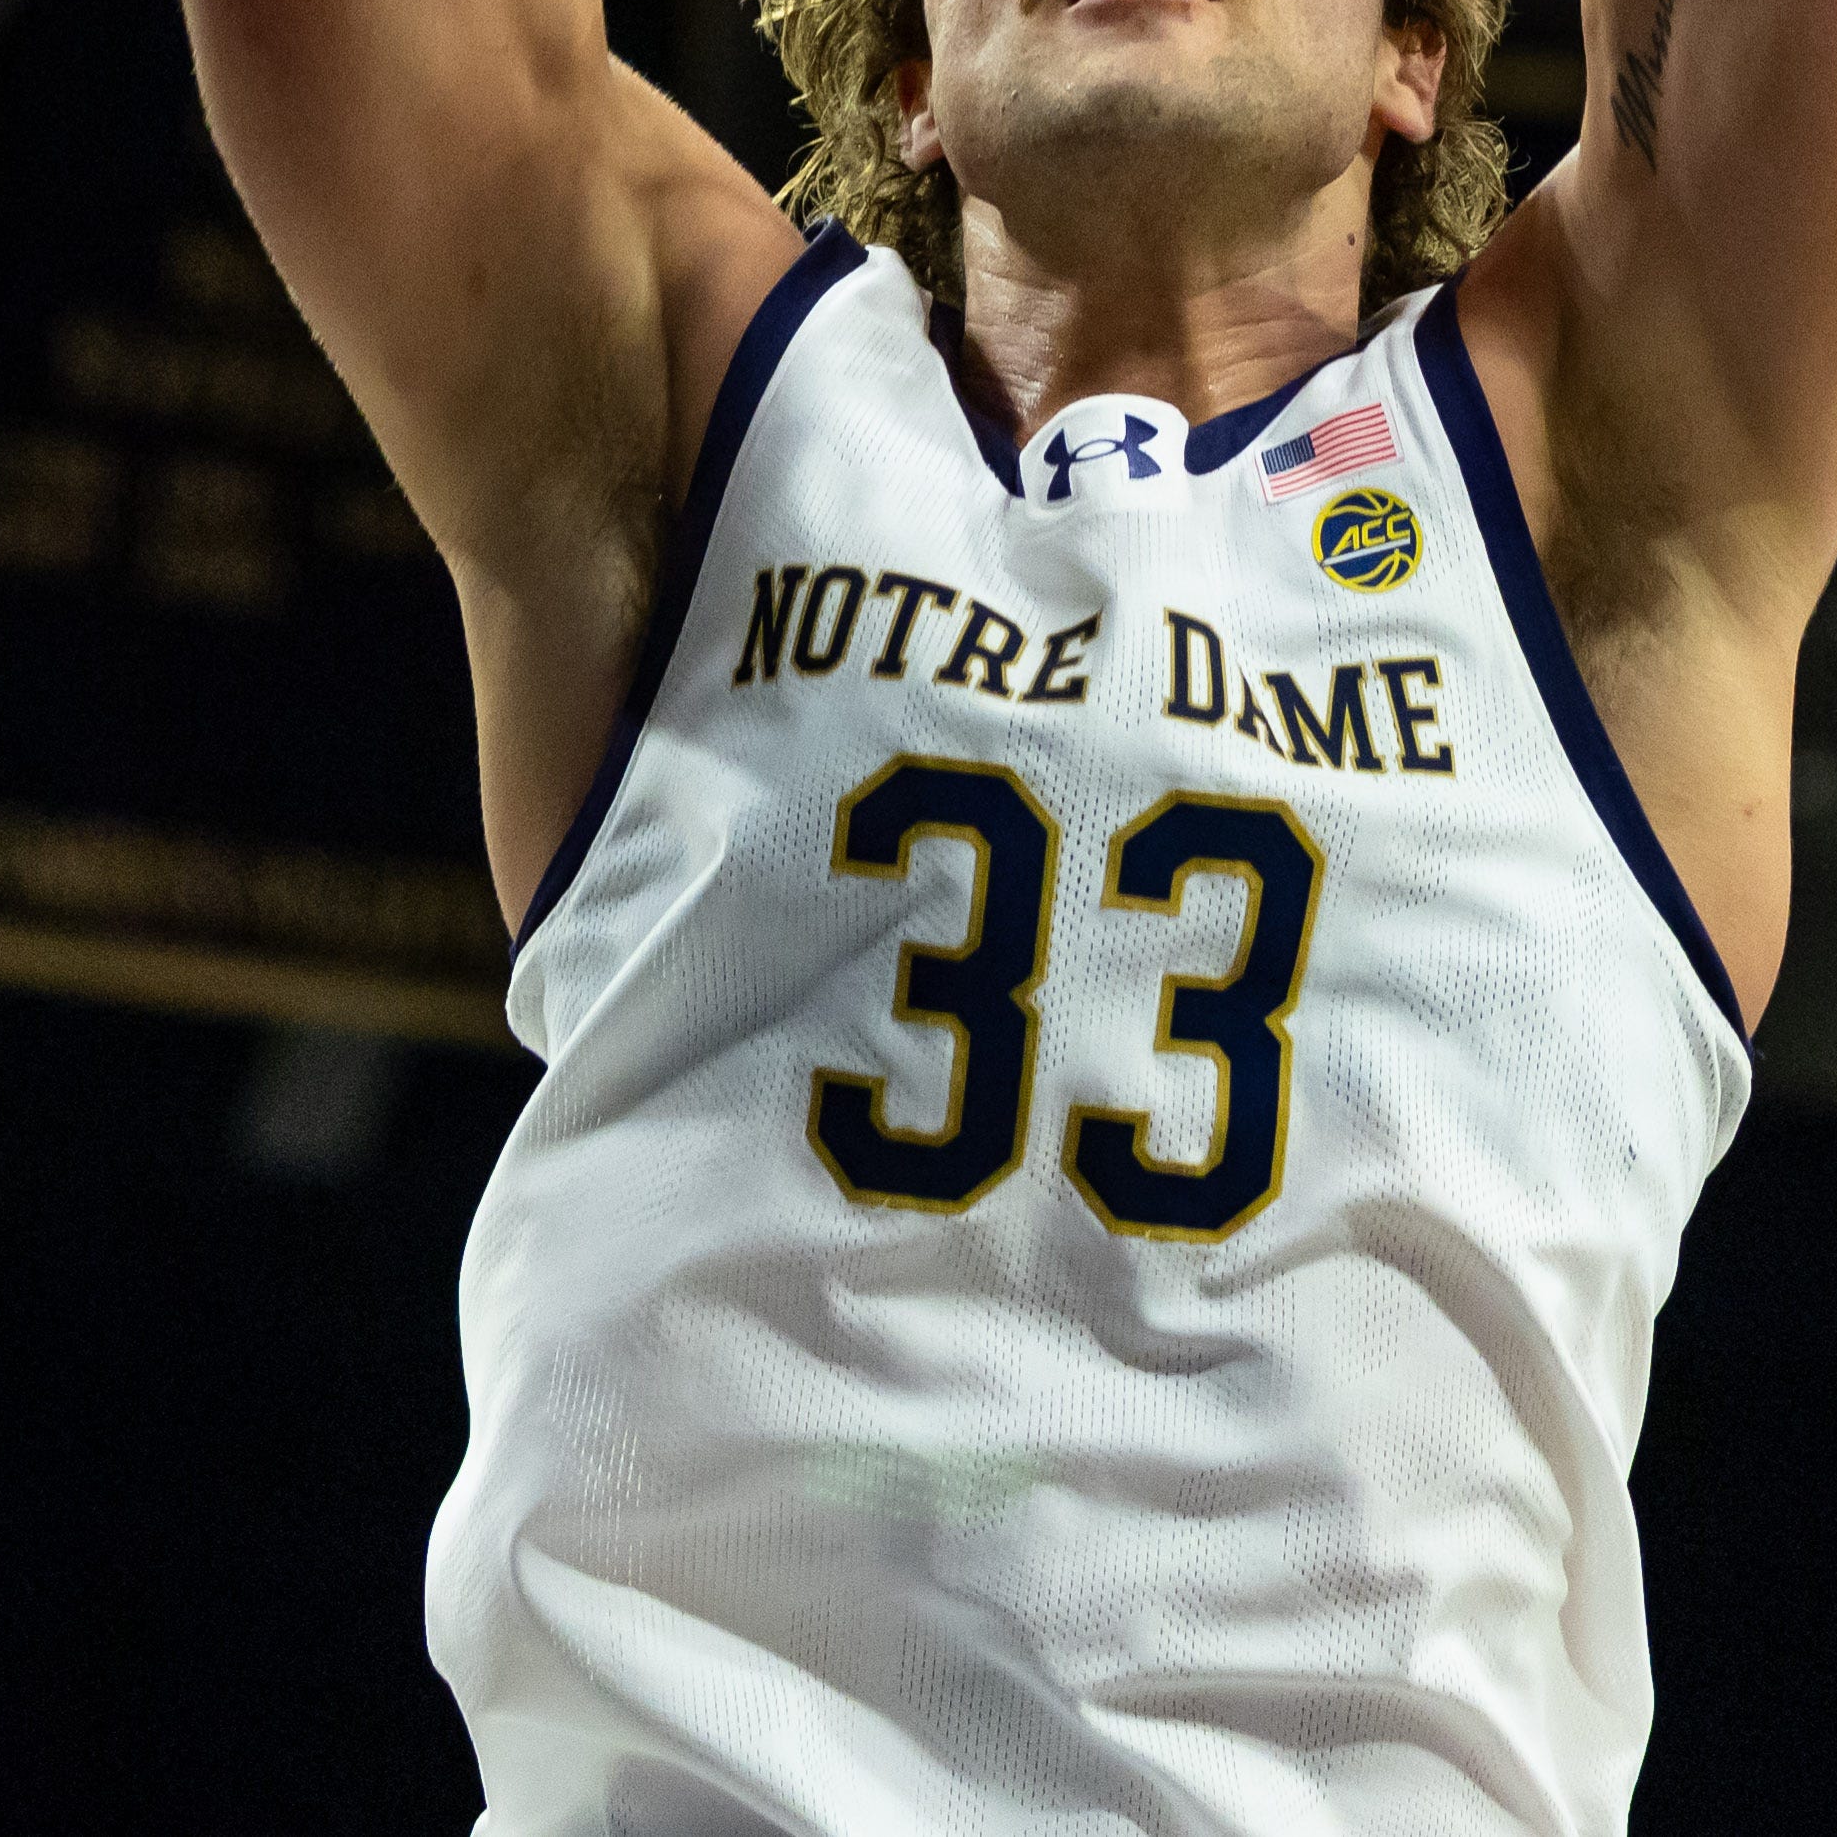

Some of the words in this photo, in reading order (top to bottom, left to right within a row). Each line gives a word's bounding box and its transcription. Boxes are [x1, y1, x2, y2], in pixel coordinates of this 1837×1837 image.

[1330, 509, 1411, 557] ACC
[731, 562, 1103, 706] NOTRE
[1162, 608, 1457, 777] DAME
[805, 753, 1325, 1246] 33
